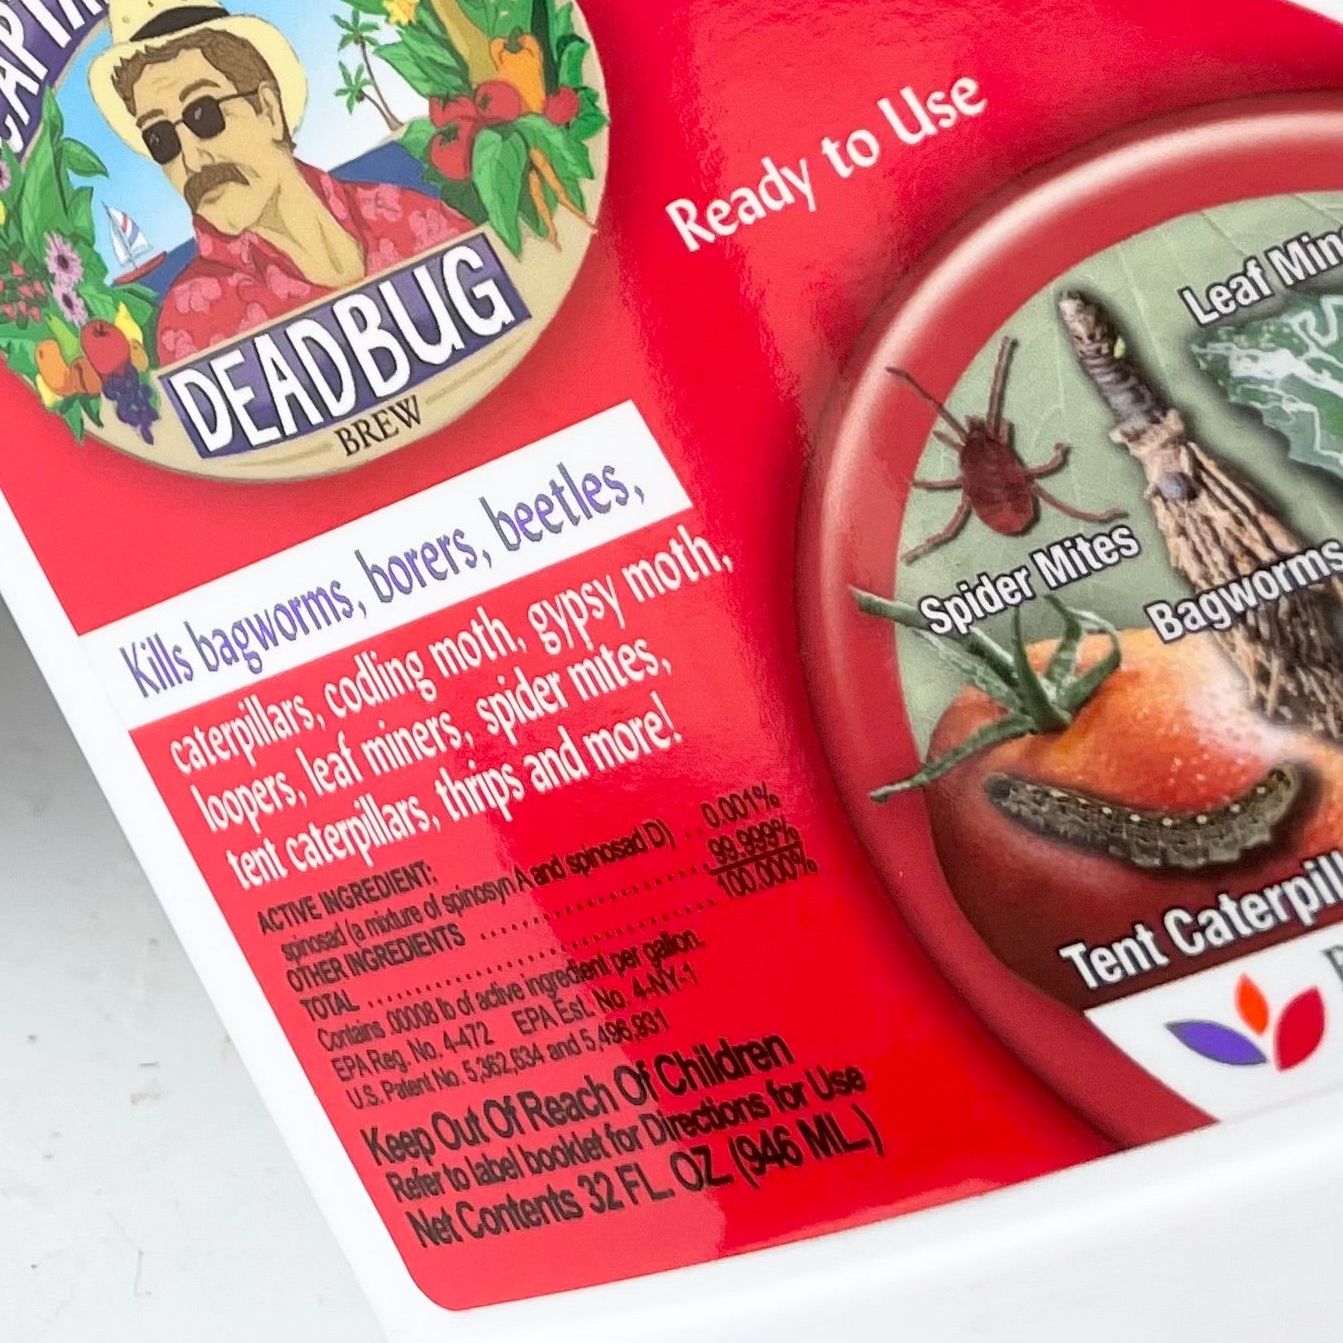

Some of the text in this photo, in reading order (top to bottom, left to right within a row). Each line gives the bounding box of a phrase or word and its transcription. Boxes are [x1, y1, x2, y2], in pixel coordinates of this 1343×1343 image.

[665, 77, 987, 252] Ready to Use
[1182, 226, 1343, 326] Leaf Min
[170, 245, 514, 453] DEADBUG
[335, 395, 423, 457] BREW
[119, 463, 645, 698] Kills bagworms, borers, beetles,
[920, 525, 1141, 635] Spider Mites
[1149, 540, 1343, 642] Bagworms
[169, 524, 733, 774] caterpillars, codling moth, gypsy moth,
[190, 634, 672, 832] loopers, leaf miners, spider mites,
[227, 690, 683, 889] tent caterpillars, thrips and more!
[257, 859, 438, 935] ACTIVE INGREDIENT:
[281, 922, 348, 962] spinosad
[365, 904, 424, 937] mixture
[423, 893, 442, 920] of
[442, 876, 516, 918] spinosyn
[514, 866, 534, 892] A
[530, 854, 566, 886] and
[566, 828, 648, 878] spinosad
[701, 781, 782, 828] 0.001%
[286, 954, 347, 993] OTHER
[343, 923, 466, 976] INGREDIENTS
[299, 989, 360, 1022] TOTAL
[317, 1019, 386, 1052] Contains
[457, 989, 475, 1015] of
[476, 980, 525, 1011] active
[521, 951, 612, 999] ingredient
[611, 948, 641, 978] per
[1059, 923, 1170, 990] Tent
[331, 1052, 372, 1082] EPA
[407, 1037, 443, 1063] No.
[443, 1021, 495, 1054] 4-472
[512, 1004, 559, 1036] EPA
[592, 986, 632, 1014] No.
[379, 1070, 435, 1102] Patent
[547, 1033, 582, 1061] and
[361, 1032, 795, 1166] Keep Out Of Reach Of Children
[386, 1062, 867, 1203] Refer to label booklet for Directions for Use
[405, 1201, 462, 1249] Net
[456, 1181, 584, 1239] Contents
[577, 1170, 626, 1216] 32
[670, 1144, 734, 1193] OZ
[730, 1123, 803, 1189] (946
